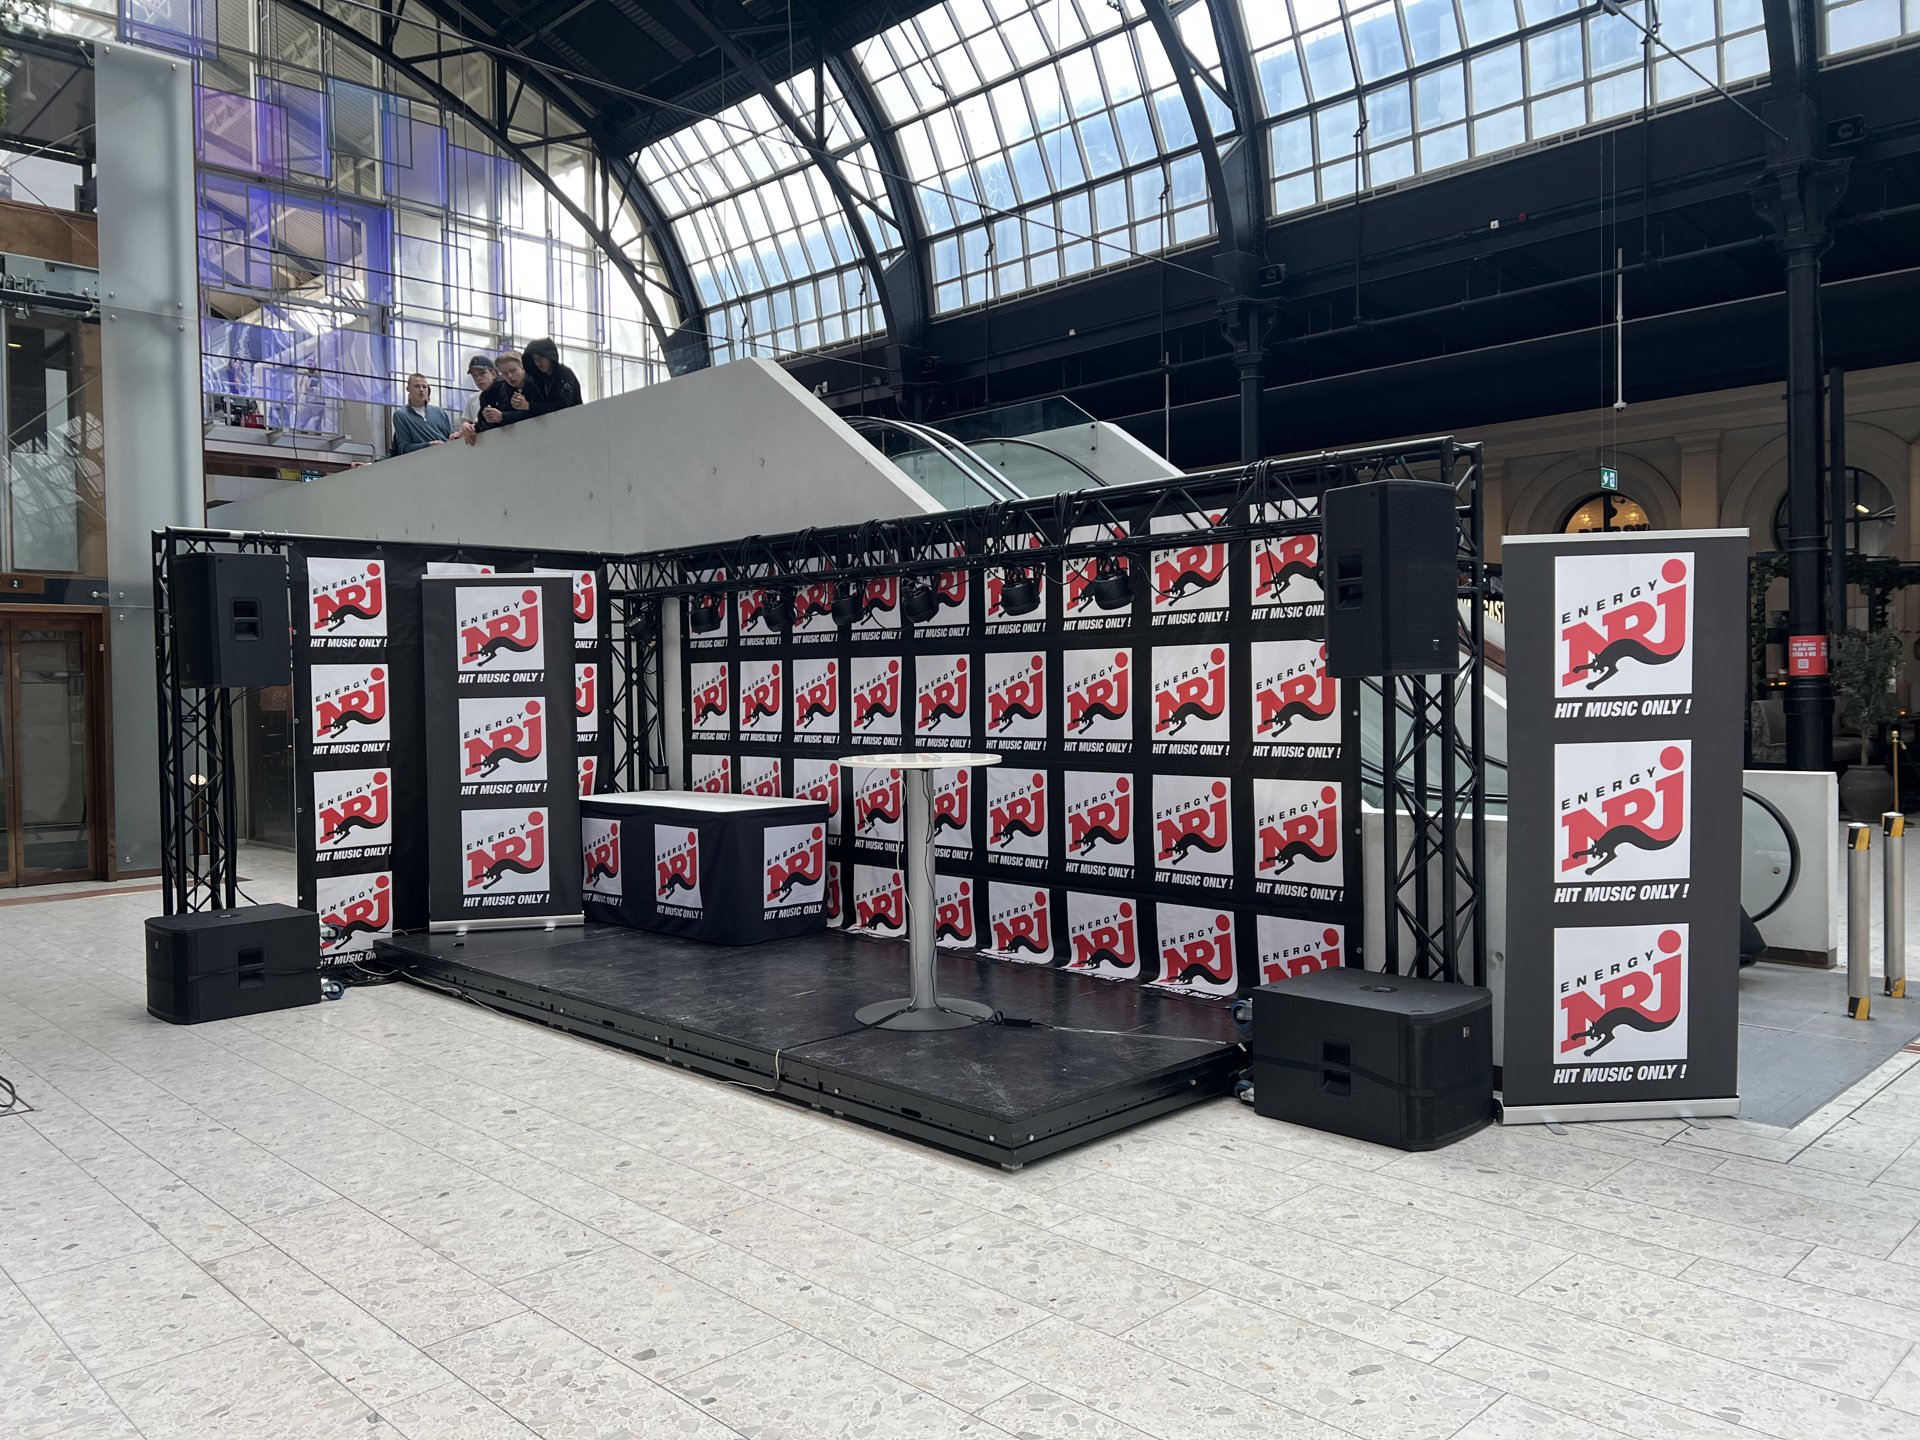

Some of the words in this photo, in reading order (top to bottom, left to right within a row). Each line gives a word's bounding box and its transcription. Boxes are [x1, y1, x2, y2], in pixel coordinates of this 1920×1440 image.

[313, 573, 365, 594] ENERGY
[1562, 580, 1657, 623] ENERGY
[461, 602, 519, 626] ENERGY
[1152, 615, 1166, 626] HIT
[1168, 613, 1196, 625] MUSIC
[1198, 612, 1222, 623] ONLY
[310, 638, 326, 647] HIT
[327, 638, 356, 647] MUSIC
[359, 638, 381, 647] ONLY
[383, 638, 386, 646] !
[458, 674, 475, 683] HIT
[477, 673, 510, 682] MUSIC
[512, 672, 538, 682] ONLY
[540, 672, 544, 681] !
[796, 672, 826, 694] ENERGY
[854, 671, 887, 694] ENERGY
[918, 669, 955, 693] ENERGY
[989, 667, 1029, 692] ENERGY
[1067, 666, 1113, 692] ENERGY
[1156, 662, 1208, 691] ENERGY
[1256, 658, 1315, 689] ENERGY
[316, 678, 368, 701] ENERGY
[1554, 702, 1582, 717] HIT
[1585, 700, 1637, 716] MUSIC
[1642, 699, 1682, 715] ONLY
[1685, 698, 1691, 713] !
[464, 712, 522, 738] ENERGY
[313, 745, 328, 754] HIT
[330, 744, 359, 753] MUSIC
[361, 742, 384, 752] ONLY
[386, 742, 389, 750] !
[803, 734, 821, 743] MUSIC
[822, 735, 836, 743] ONLY
[851, 736, 861, 744] HIT
[862, 736, 882, 745] MUSIC
[883, 736, 898, 745] ONLY
[915, 738, 926, 746] HIT
[927, 738, 948, 747] MUSIC
[950, 738, 966, 747] ONLY
[986, 739, 997, 748] HIT
[998, 740, 1022, 749] MUSIC
[1023, 740, 1042, 750] ONLY
[1064, 741, 1077, 751] HIT
[1078, 742, 1104, 752] MUSIC
[1106, 742, 1127, 752] ONLY
[1152, 743, 1167, 753] HIT
[1168, 744, 1198, 754] MUSIC
[1200, 744, 1224, 755] ONLY
[1252, 745, 1269, 756] HIT
[1271, 746, 1304, 757] MUSIC
[1307, 746, 1334, 758] ONLY
[319, 784, 370, 809] ENERGY
[460, 785, 478, 794] HIT
[480, 784, 512, 794] MUSIC
[515, 783, 540, 793] ONLY
[543, 782, 547, 791] !
[990, 785, 1030, 806] ENERGY
[1562, 767, 1654, 810] ENERGY
[1068, 790, 1114, 812] ENERGY
[1158, 794, 1209, 818] ENERGY
[1259, 800, 1317, 825] ENERGY
[467, 823, 525, 850] ENERGY
[316, 851, 332, 861] HIT
[333, 850, 362, 860] MUSIC
[364, 848, 386, 858] ONLY
[387, 846, 392, 855] !
[658, 841, 687, 861] ENERGY
[767, 838, 809, 865] ENERGY
[988, 853, 998, 863] HIT
[1000, 855, 1023, 866] MUSIC
[1024, 857, 1044, 868] ONLY
[1065, 862, 1079, 872] HIT
[1080, 863, 1106, 875] MUSIC
[1108, 866, 1129, 878] ONLY
[1155, 871, 1170, 882] HIT
[1171, 873, 1200, 885] MUSIC
[1203, 876, 1227, 888] ONLY
[320, 887, 374, 915] ENERGY
[463, 897, 480, 906] HIT
[482, 895, 515, 906] MUSIC
[517, 894, 543, 904] ONLY
[545, 893, 549, 902] !
[1256, 882, 1272, 893] HIT
[1274, 883, 1308, 897] MUSIC
[1310, 887, 1336, 900] ONLY
[1554, 887, 1581, 902] HIT
[1584, 886, 1635, 901] MUSIC
[1640, 884, 1679, 899] ONLY
[1682, 883, 1689, 898] !
[656, 905, 664, 914] HIT
[665, 907, 683, 917] MUSIC
[683, 910, 698, 919] ONLY
[764, 910, 777, 920] HIT
[778, 906, 801, 918] MUSIC
[803, 904, 822, 914] ONLY
[1072, 913, 1118, 934] ENERGY
[1162, 926, 1214, 948] ENERGY
[334, 952, 364, 965] MUSIC
[1263, 940, 1322, 963] ENERGY
[1561, 950, 1652, 992] ENERGY
[1553, 1068, 1579, 1083] HIT
[1582, 1066, 1633, 1082] MUSIC
[1637, 1064, 1677, 1080] ONLY
[1680, 1064, 1686, 1078] !
